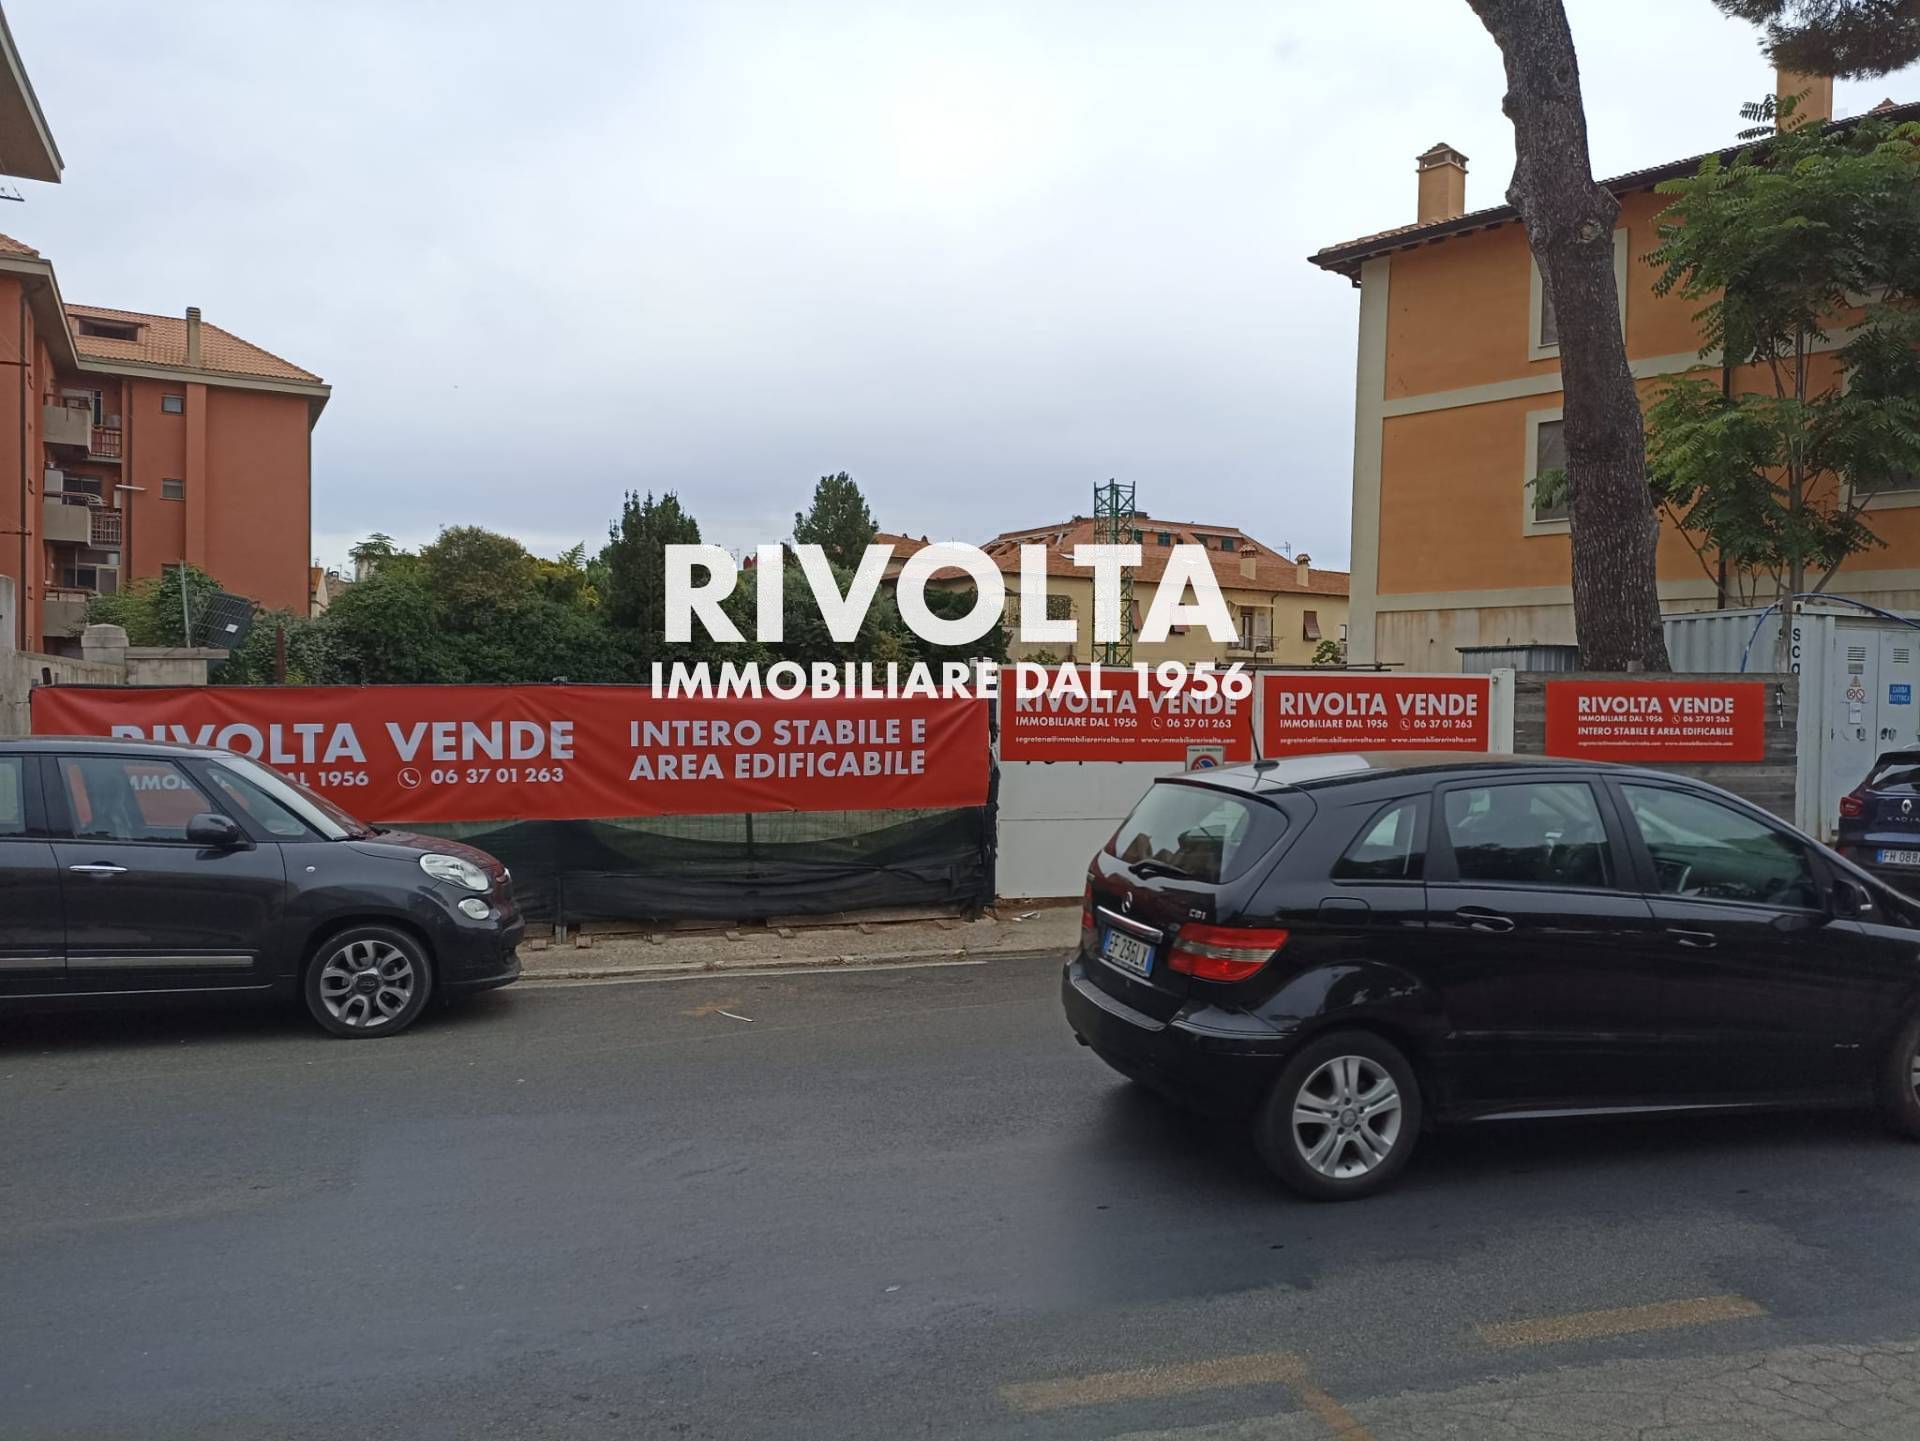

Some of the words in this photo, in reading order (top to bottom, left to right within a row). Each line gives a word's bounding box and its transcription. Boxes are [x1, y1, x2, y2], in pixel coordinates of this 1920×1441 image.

[1279, 692, 1388, 716] RIVOLTA
[1395, 693, 1478, 716] VENDE
[1578, 696, 1663, 714] RIVOLTA
[1668, 697, 1734, 714] VENDE
[1015, 716, 1087, 727] IMMOBILIARE
[1089, 717, 1110, 728] DAL
[1113, 717, 1138, 728] 1956
[1166, 718, 1181, 729] 06
[1183, 718, 1196, 729] 37
[1198, 718, 1209, 728] 01
[1211, 718, 1232, 729] 263
[1280, 718, 1343, 729] IMMOBILIARE
[1345, 719, 1364, 729] DAL
[1366, 719, 1389, 729] 1956
[1413, 719, 1427, 729] 06
[1429, 719, 1441, 729] 37
[1442, 719, 1453, 729] 01
[1455, 719, 1473, 729] 263
[1578, 714, 1628, 722] IMMOBILIARE
[1629, 714, 1643, 722] DAL
[1645, 714, 1664, 723] 1956
[1682, 715, 1693, 723] 06
[1695, 715, 1705, 723] 37
[1705, 715, 1714, 723] 01
[1715, 715, 1730, 723] 263
[631, 719, 762, 747] INTERO
[773, 719, 901, 746] STABILE
[911, 719, 926, 744] E
[1578, 727, 1612, 736] INTERO
[1613, 727, 1648, 736] STABILE
[1650, 727, 1656, 736] E
[1657, 727, 1681, 736] AREA
[1682, 727, 1734, 737] EDIFICABILE
[384, 721, 574, 762] VENDE
[629, 753, 725, 781] AREA
[735, 750, 926, 779] EDIFICABILE
[318, 771, 369, 787] 1956
[430, 768, 459, 785] 06
[465, 768, 491, 784] 37
[495, 768, 518, 783] 01
[524, 767, 564, 783] 263
[1884, 851, 1896, 862] FH
[1899, 852, 1920, 864] 088
